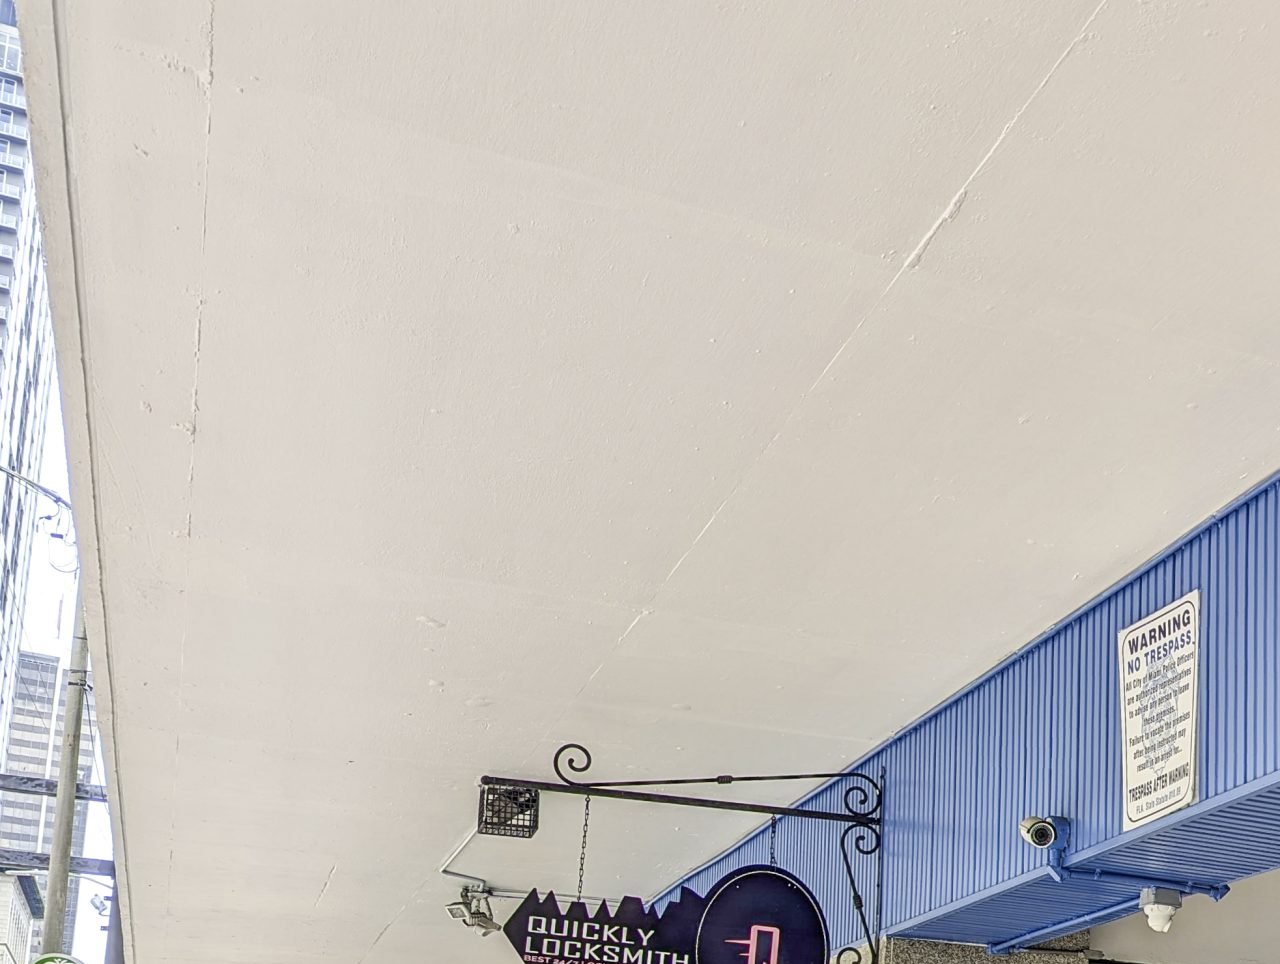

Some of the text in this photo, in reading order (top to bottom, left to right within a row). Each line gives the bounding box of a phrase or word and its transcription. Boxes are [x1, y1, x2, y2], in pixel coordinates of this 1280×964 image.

[1128, 609, 1191, 655] WARNING
[1127, 656, 1141, 675] NO
[1129, 780, 1153, 803] TRESPASS
[1153, 773, 1168, 792] AFTER
[1168, 762, 1189, 787] WARNING
[527, 915, 655, 946] QUICKLY
[523, 954, 551, 964] BEST
